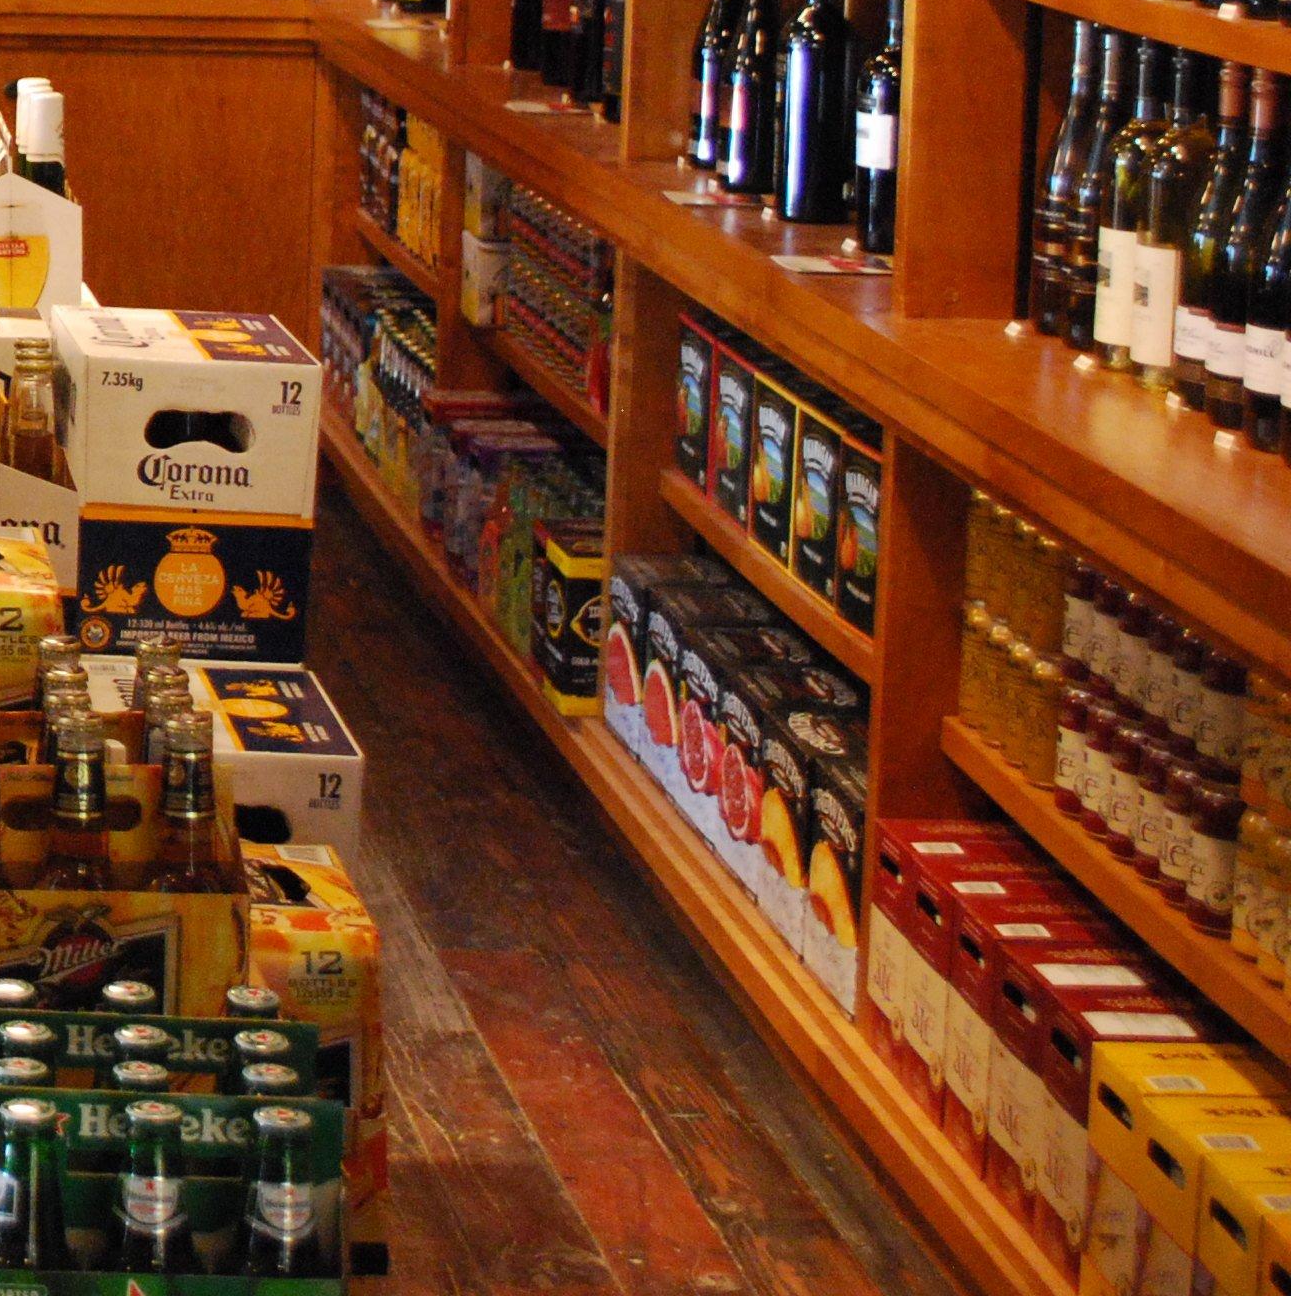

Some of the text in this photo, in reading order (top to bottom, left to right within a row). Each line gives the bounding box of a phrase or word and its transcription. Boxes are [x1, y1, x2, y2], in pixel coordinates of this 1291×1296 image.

[101, 371, 144, 391] 7.35kg
[280, 381, 303, 405] 12
[136, 453, 253, 491] Corona
[169, 484, 215, 502] Extra
[159, 573, 219, 585] CERVEZA
[181, 563, 198, 573] LA
[192, 632, 218, 642] FROM
[219, 633, 256, 644] MEXICO
[319, 773, 343, 799] 12
[38, 938, 118, 977] Miller
[300, 950, 344, 975] 12
